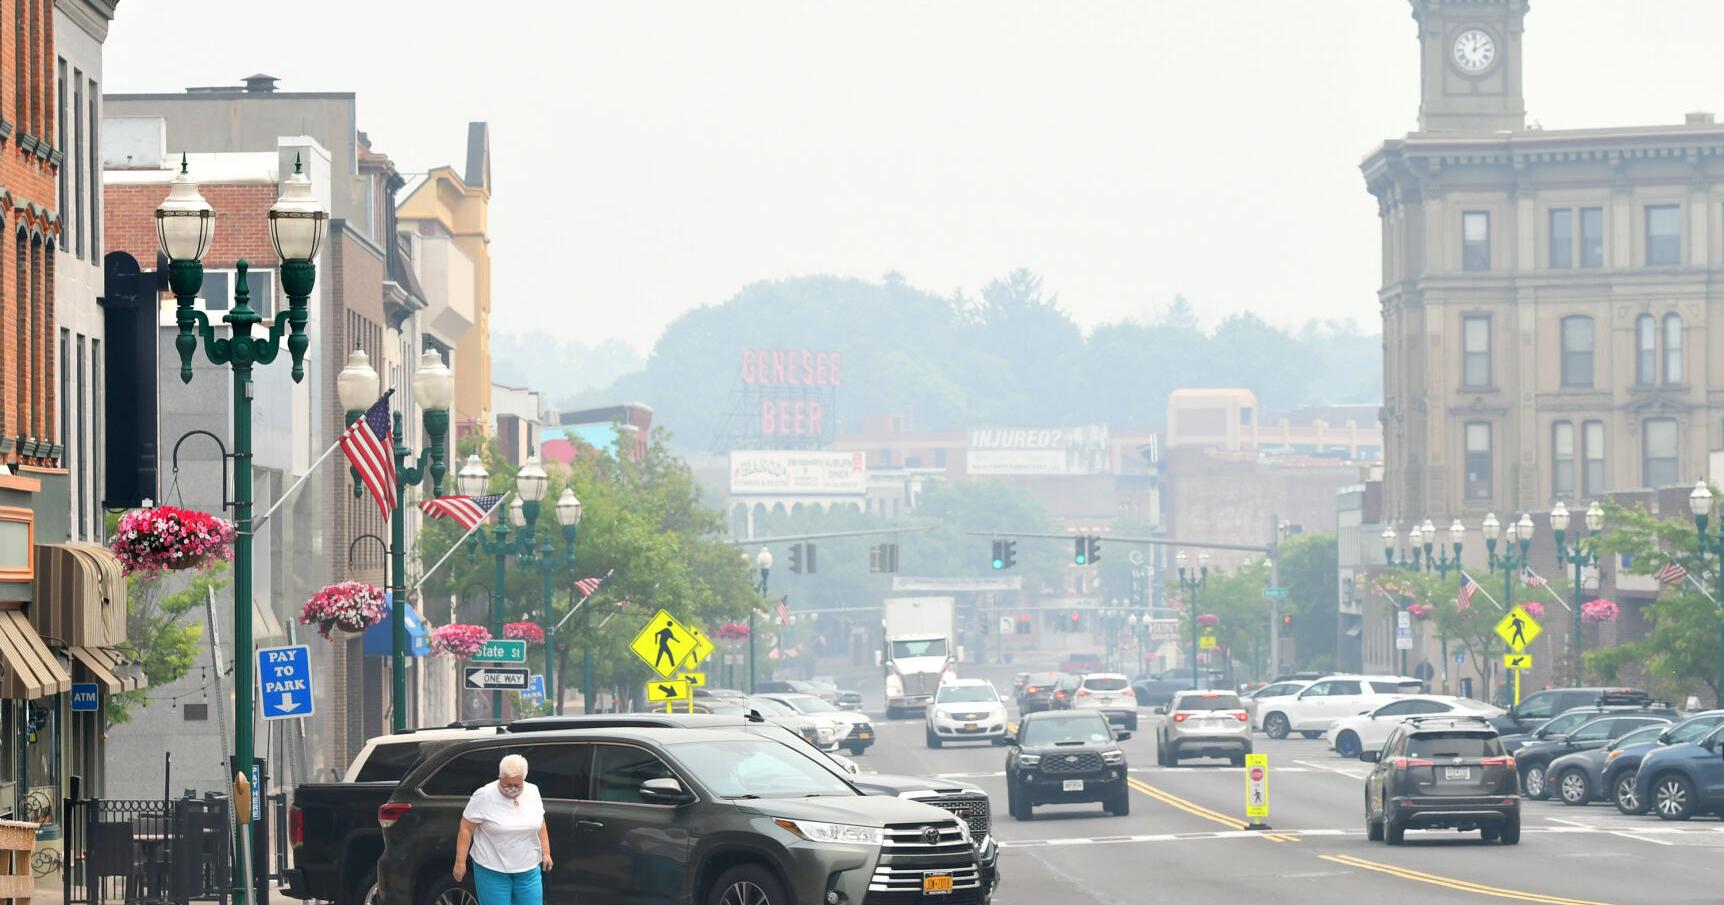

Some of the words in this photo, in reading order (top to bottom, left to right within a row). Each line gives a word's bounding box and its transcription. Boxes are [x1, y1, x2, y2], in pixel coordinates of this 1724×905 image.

[741, 351, 841, 385] GENESEE
[762, 400, 821, 433] BEER
[971, 429, 1062, 449] INJURED?
[268, 650, 297, 663] PAY
[475, 645, 504, 658] State
[511, 647, 521, 658] St
[274, 665, 294, 677] TO
[484, 674, 501, 683] ONE
[504, 675, 522, 684] WAY
[266, 679, 306, 693] PARK
[74, 692, 96, 702] ATM
